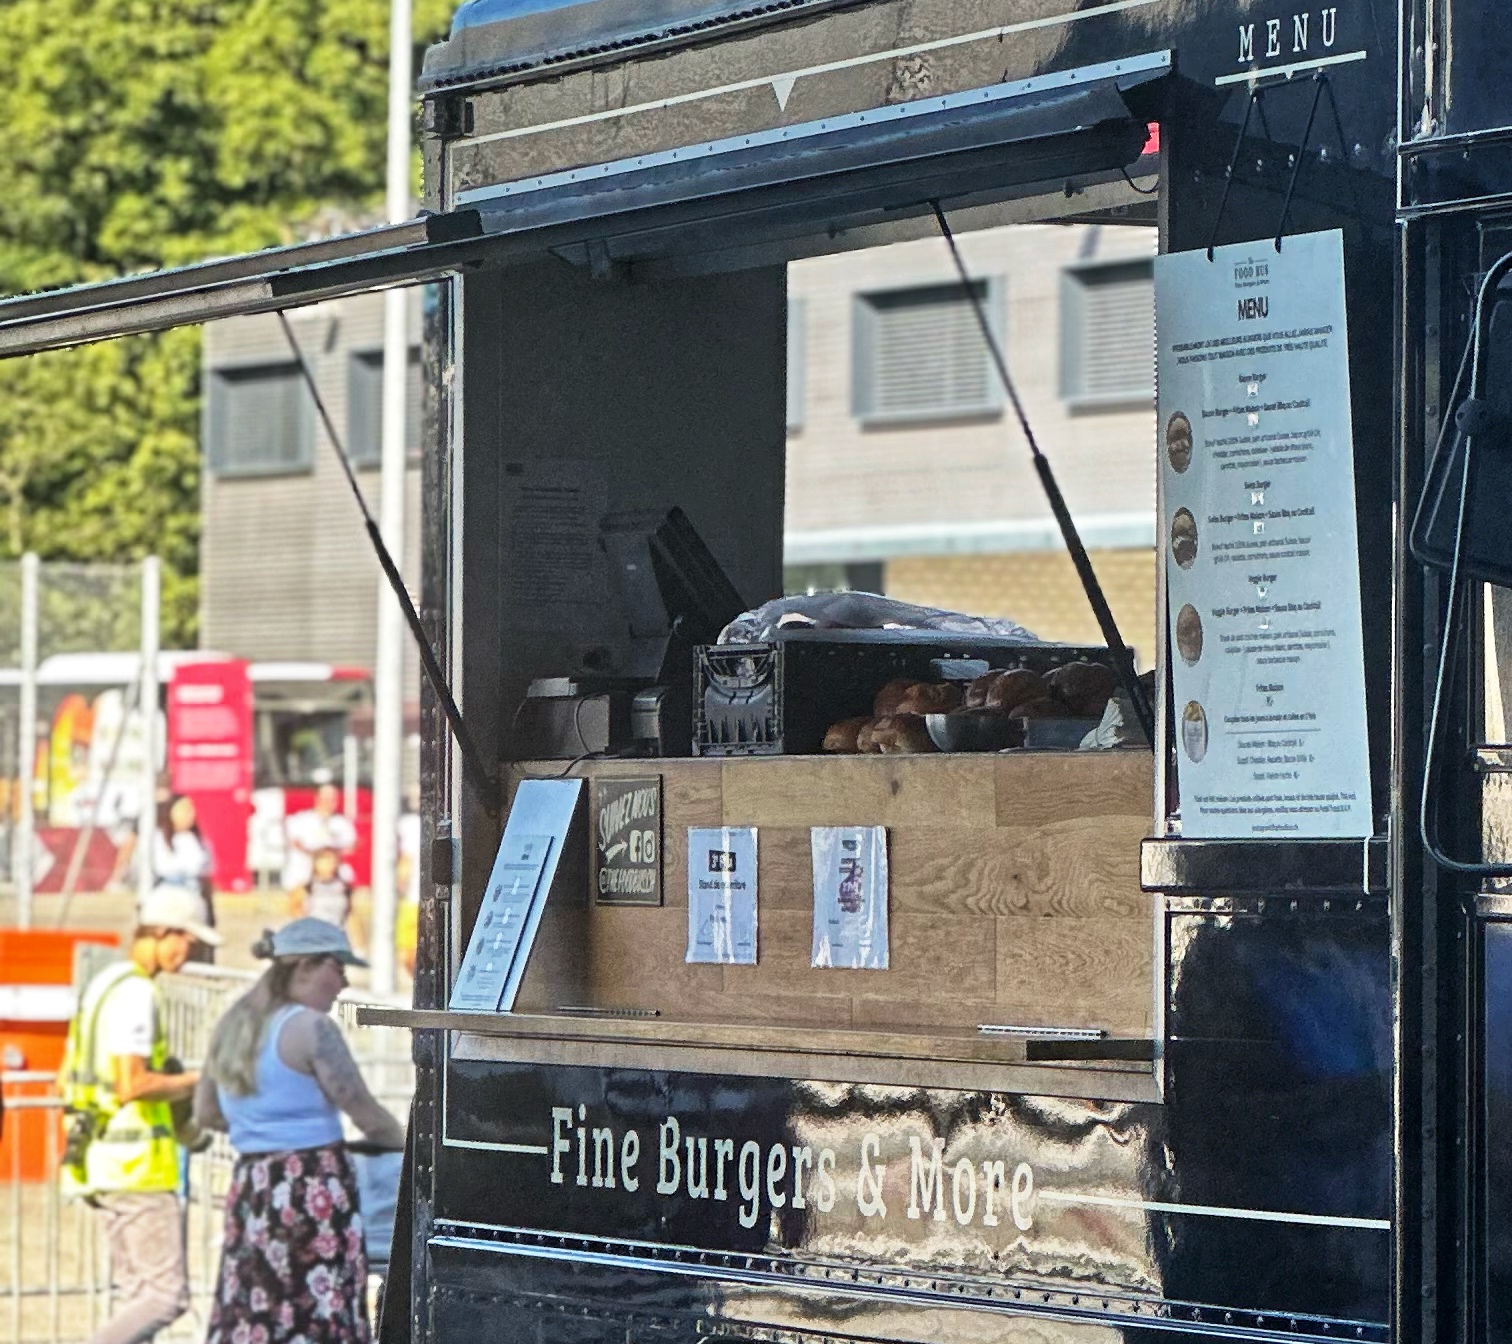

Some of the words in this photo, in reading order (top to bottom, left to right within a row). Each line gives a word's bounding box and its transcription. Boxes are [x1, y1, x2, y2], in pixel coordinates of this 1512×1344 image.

[1237, 7, 1338, 64] MENU
[1237, 296, 1269, 321] MENU
[550, 1103, 640, 1193] Fine
[656, 1116, 836, 1229] Burgers
[856, 1132, 887, 1220] &
[906, 1135, 1034, 1231] More
